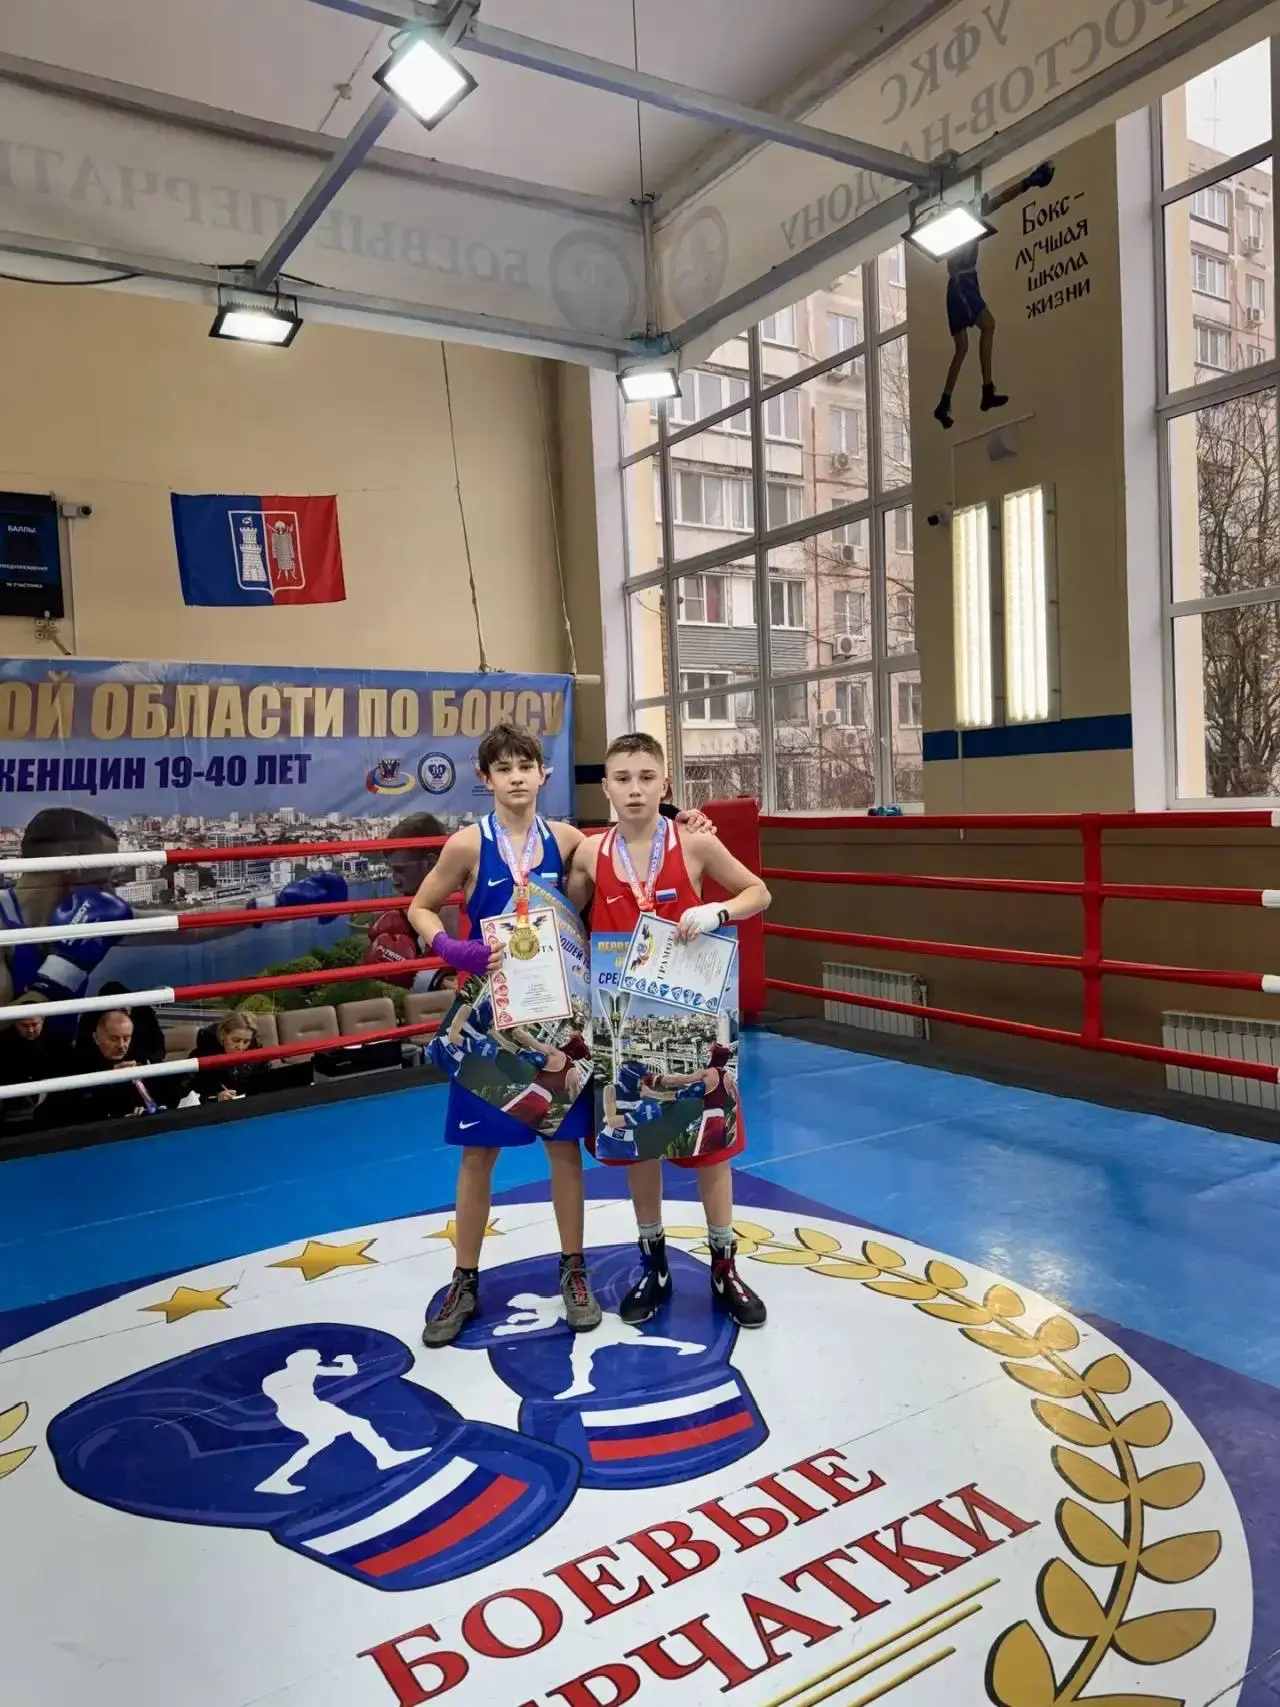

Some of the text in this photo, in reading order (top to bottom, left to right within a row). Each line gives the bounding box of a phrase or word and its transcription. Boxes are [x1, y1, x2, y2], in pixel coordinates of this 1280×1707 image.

[1015, 218, 1089, 273] лучшая
[1027, 251, 1089, 292] школа
[1025, 278, 1092, 320] жизни
[89, 681, 346, 740] ОБЛАСТИ
[356, 687, 419, 739] ПО
[430, 688, 566, 739] БОКСУ
[154, 755, 250, 789] 19-40
[254, 753, 312, 786] ЛЕТ
[356, 1447, 888, 1707] БОЕВЫЕ
[517, 1482, 1041, 1707] РЧАТКИ
